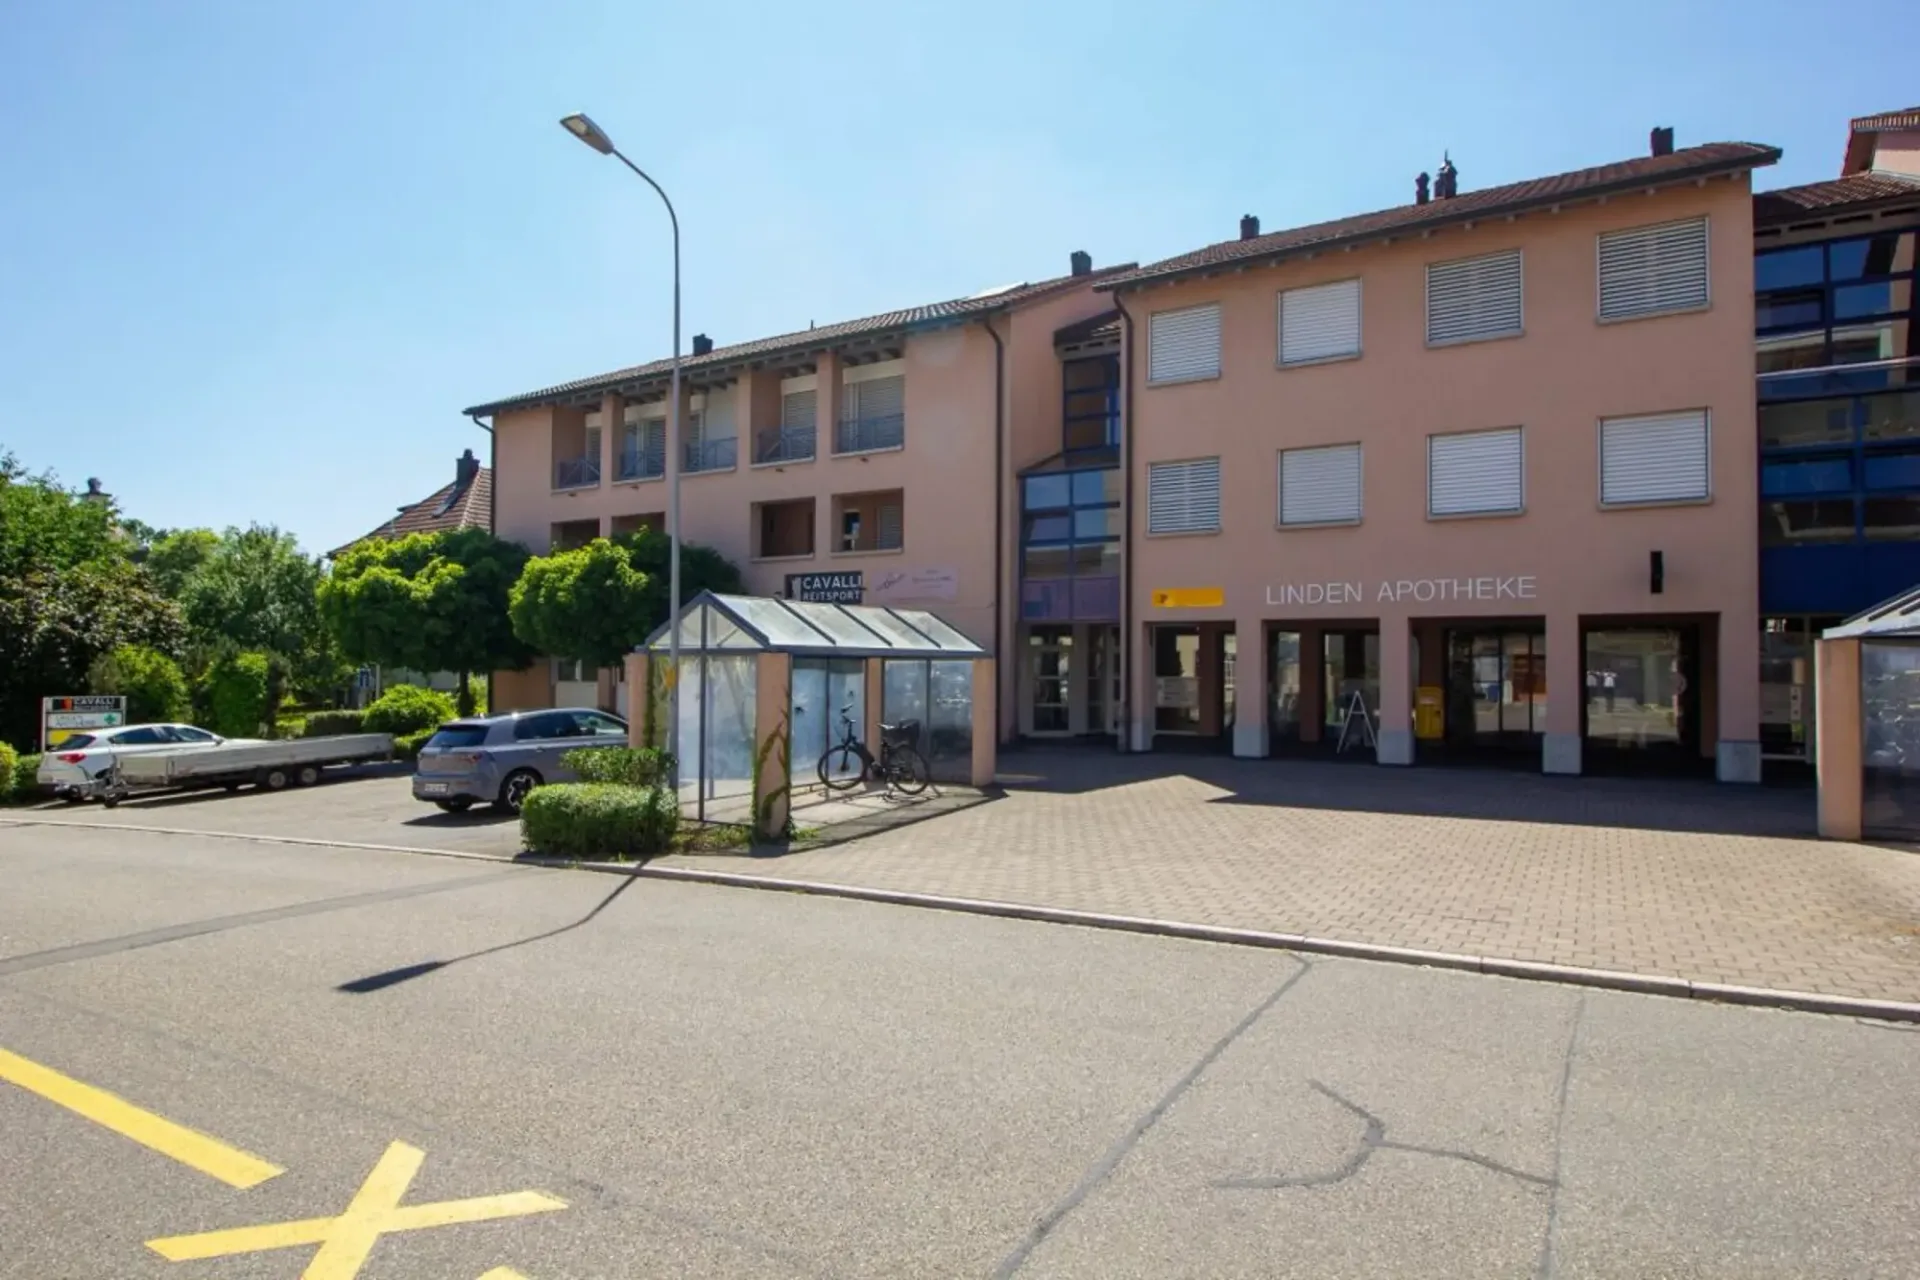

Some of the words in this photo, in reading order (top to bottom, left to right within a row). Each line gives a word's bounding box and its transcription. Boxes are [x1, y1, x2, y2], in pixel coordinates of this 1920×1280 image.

[803, 575, 862, 590] CAVALLI
[803, 590, 861, 602] REITSPORT
[1265, 581, 1363, 605] LINDEN
[1376, 576, 1537, 602] APOTHEKE
